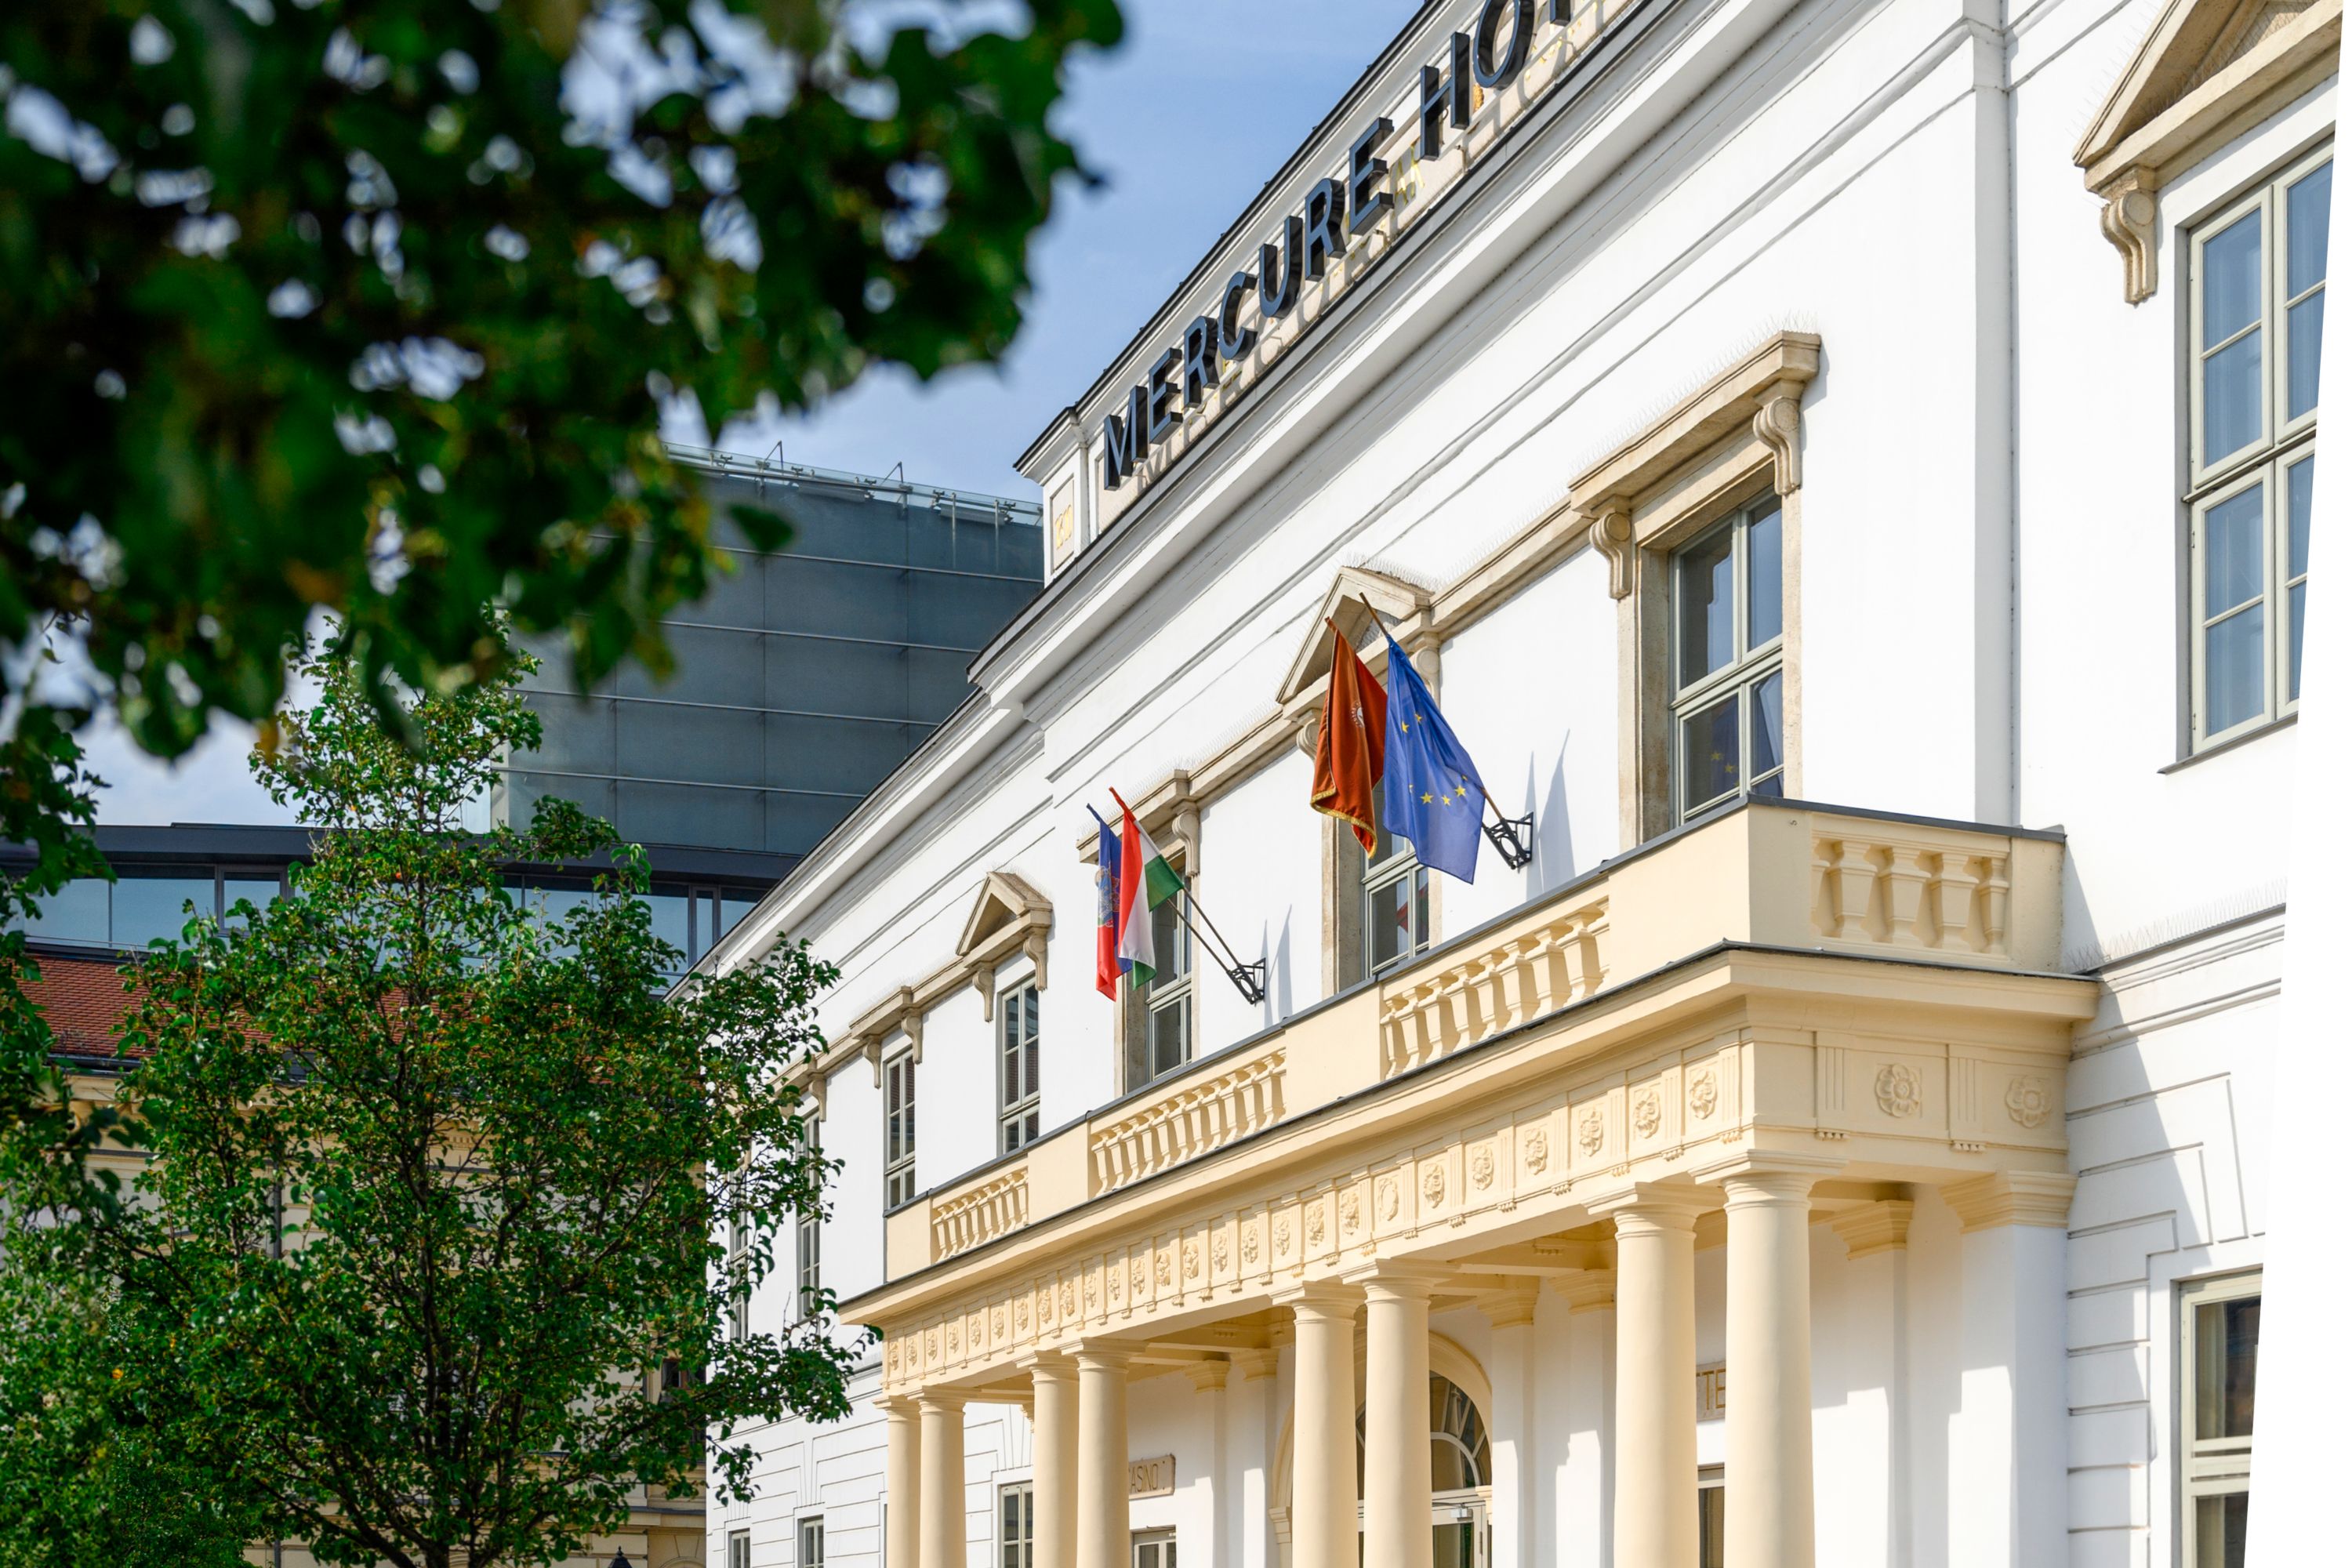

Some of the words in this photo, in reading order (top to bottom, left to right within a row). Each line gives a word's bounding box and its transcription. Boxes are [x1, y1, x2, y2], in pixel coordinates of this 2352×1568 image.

[1104, 117, 1394, 491] MERCURE
[1420, 0, 1571, 161] HO
[1128, 1463, 1159, 1494] ASINO
